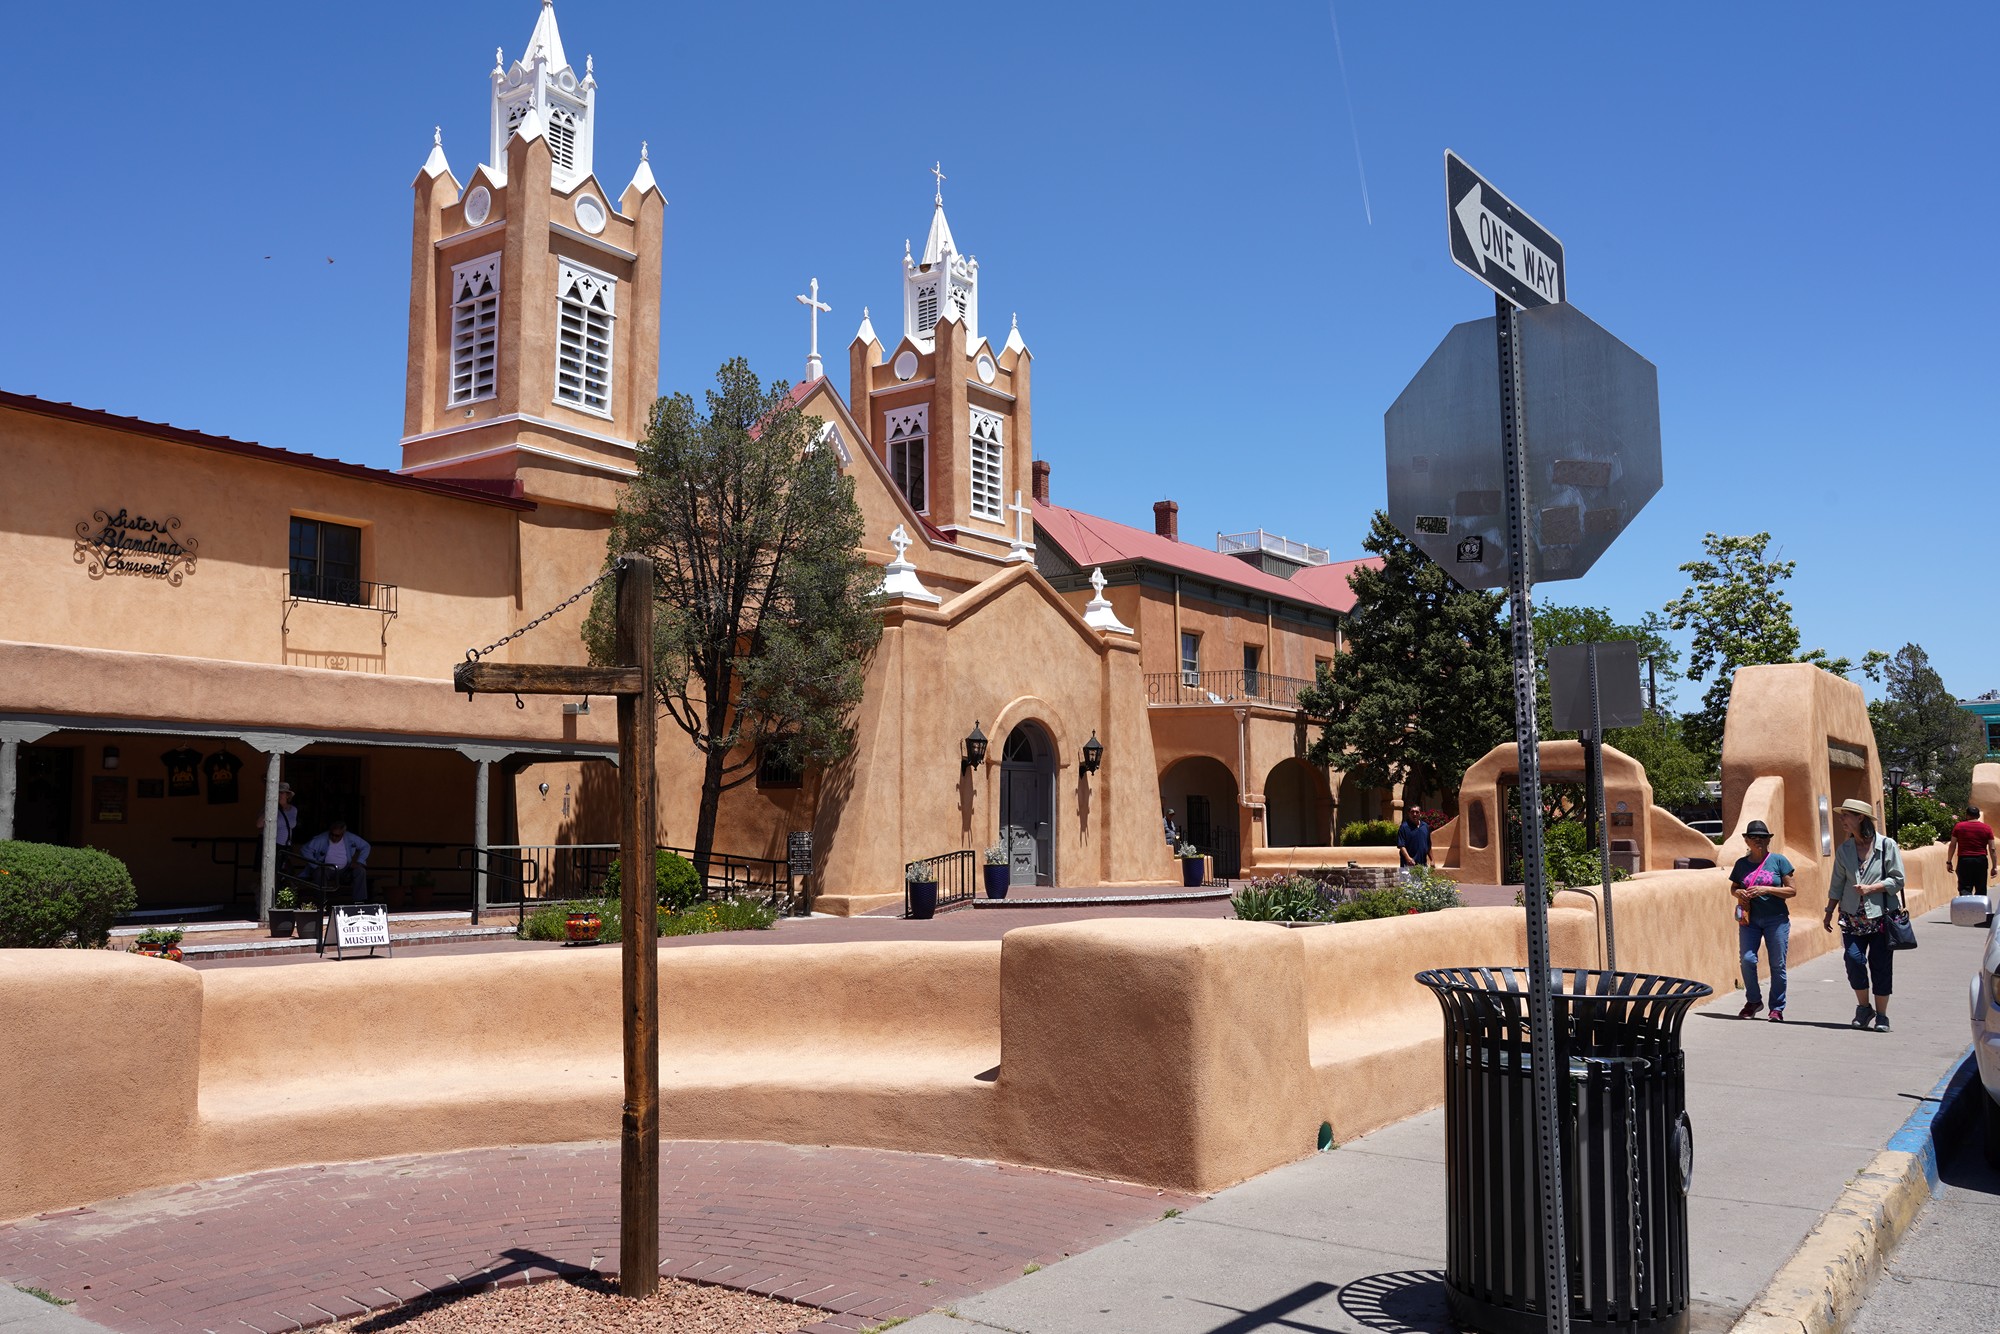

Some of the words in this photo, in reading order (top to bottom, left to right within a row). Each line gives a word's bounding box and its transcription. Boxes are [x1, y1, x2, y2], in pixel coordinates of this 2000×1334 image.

[1479, 211, 1516, 272] ONE
[1522, 243, 1555, 299] WAY
[108, 508, 167, 534] Sister
[104, 550, 169, 576] Convent
[344, 935, 385, 944] MUSEUM
